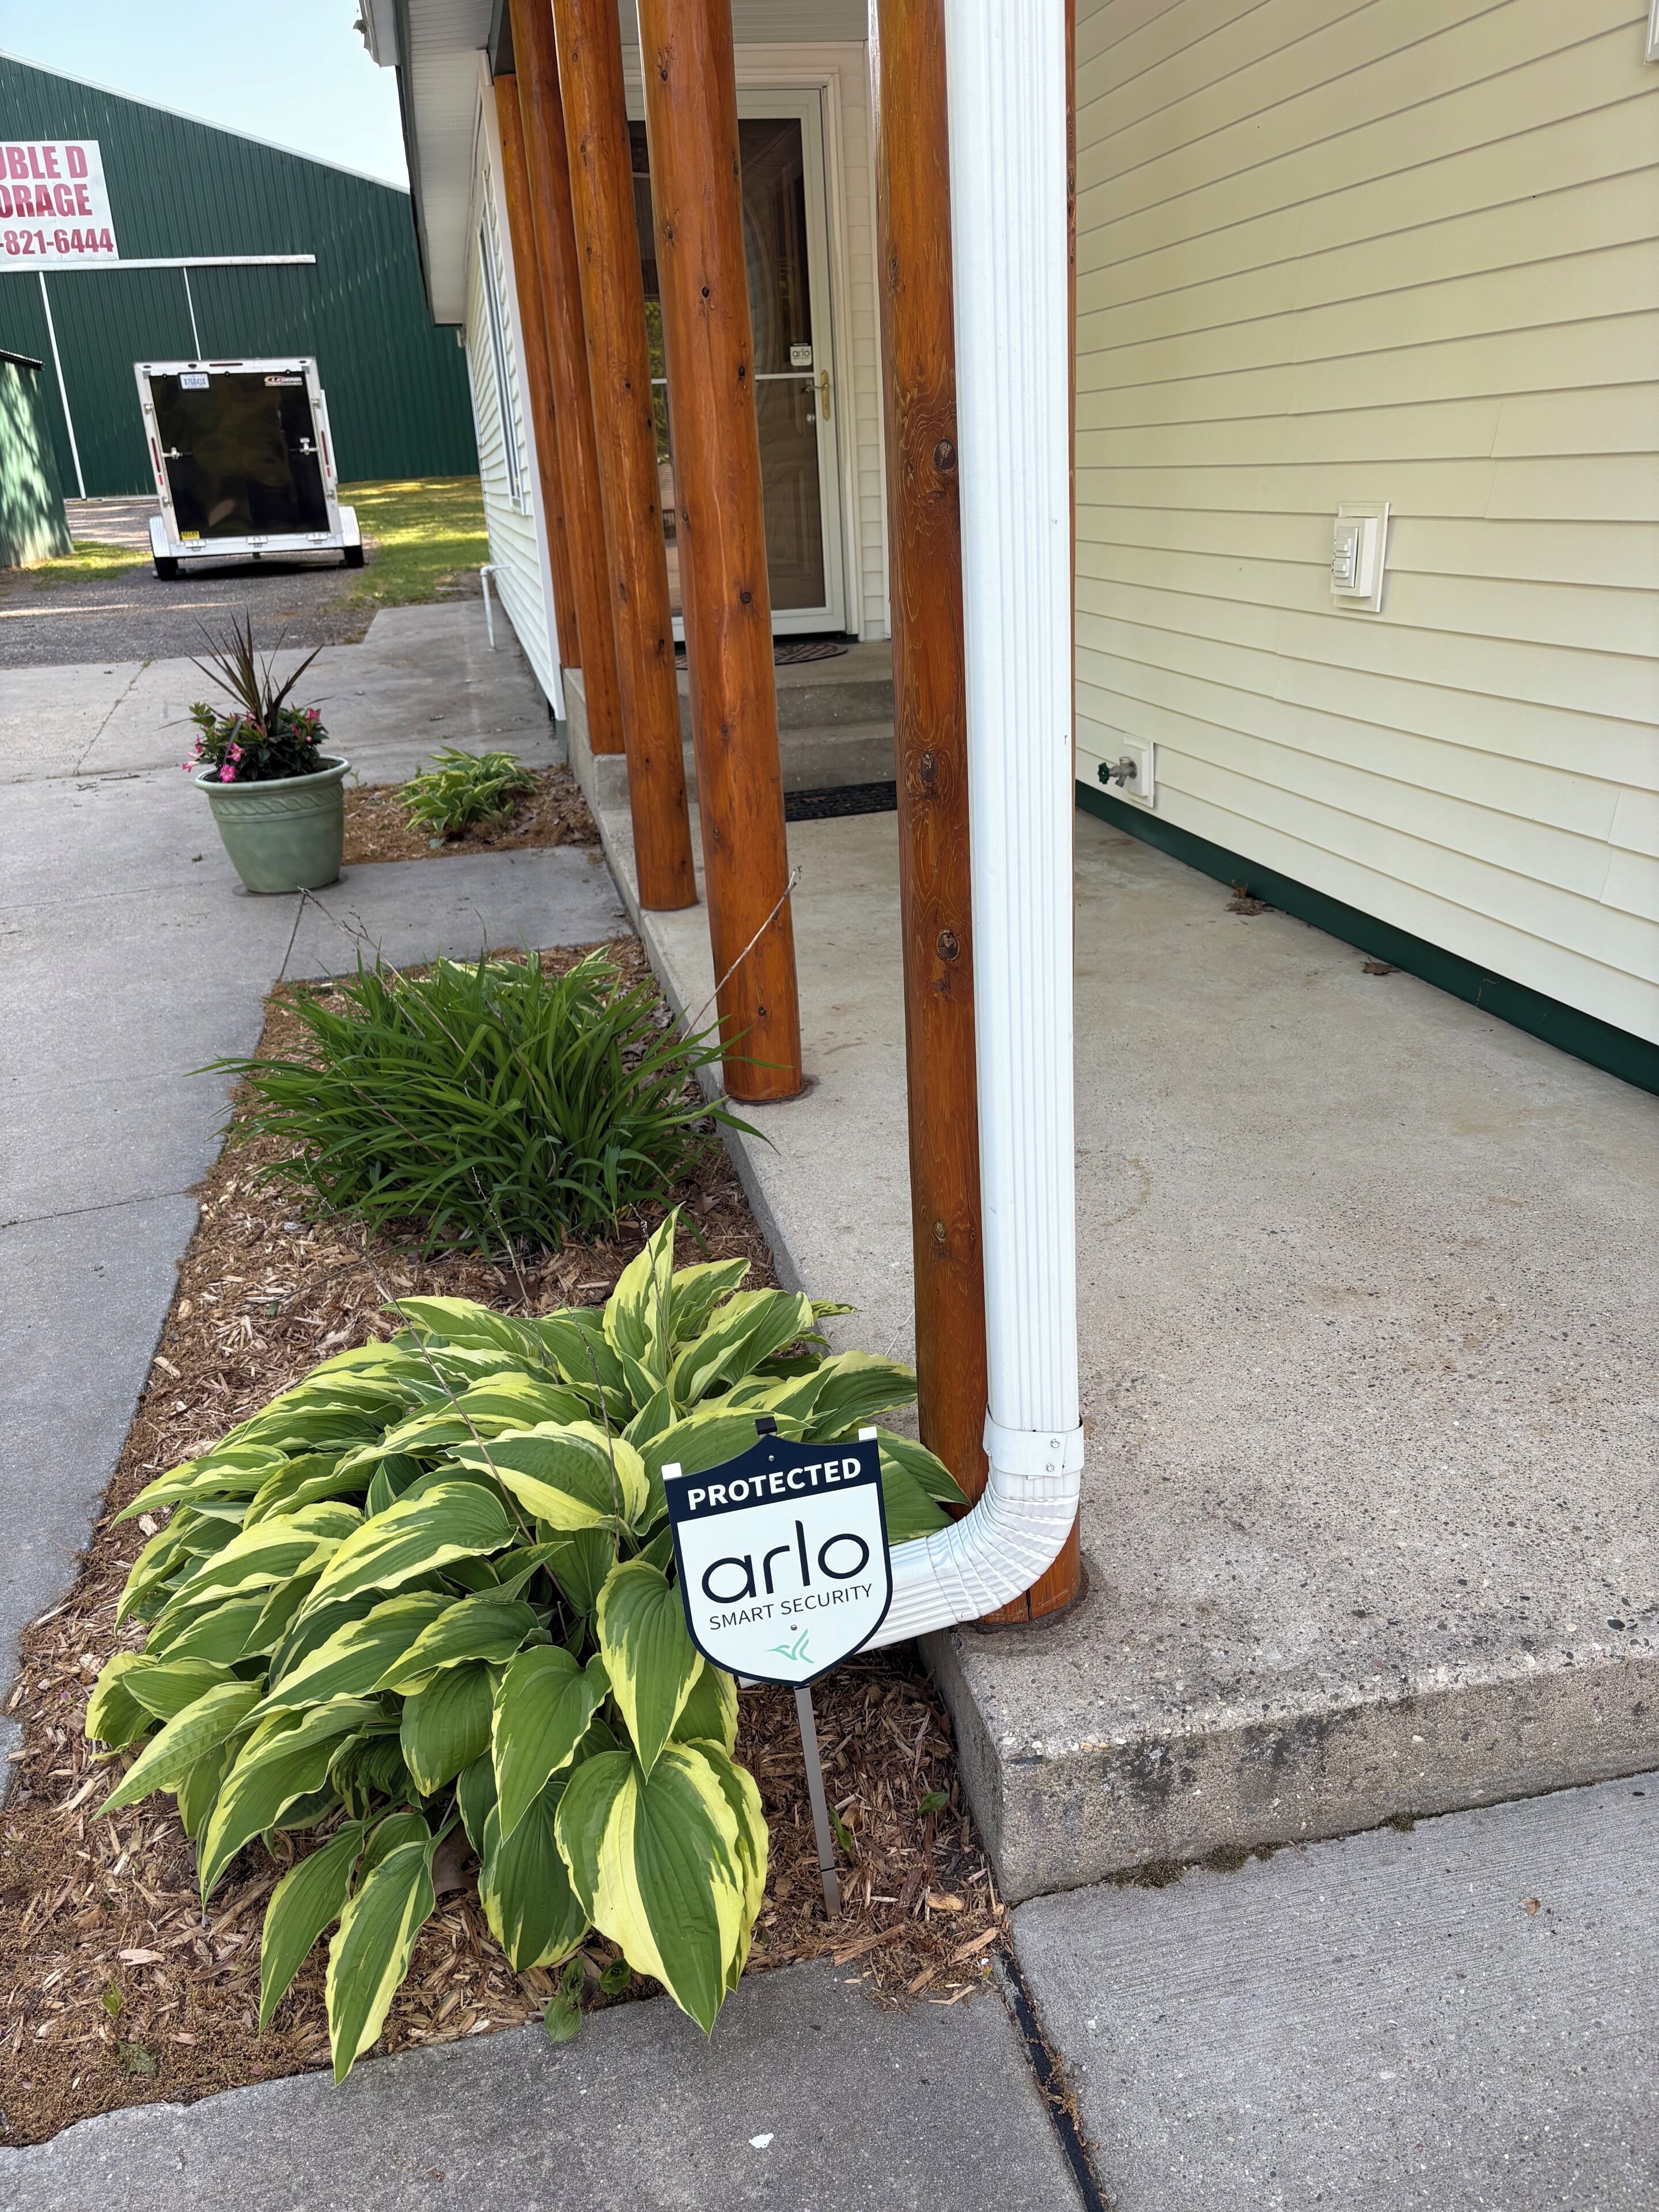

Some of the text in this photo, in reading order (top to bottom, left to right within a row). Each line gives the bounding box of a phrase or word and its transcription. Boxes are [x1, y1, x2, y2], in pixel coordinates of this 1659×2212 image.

[65, 146, 88, 178] D
[793, 348, 810, 357] arlo
[687, 1458, 861, 1510] PROTECTED
[702, 1520, 870, 1604] arlo
[709, 1583, 872, 1630] SMART SECURITY
